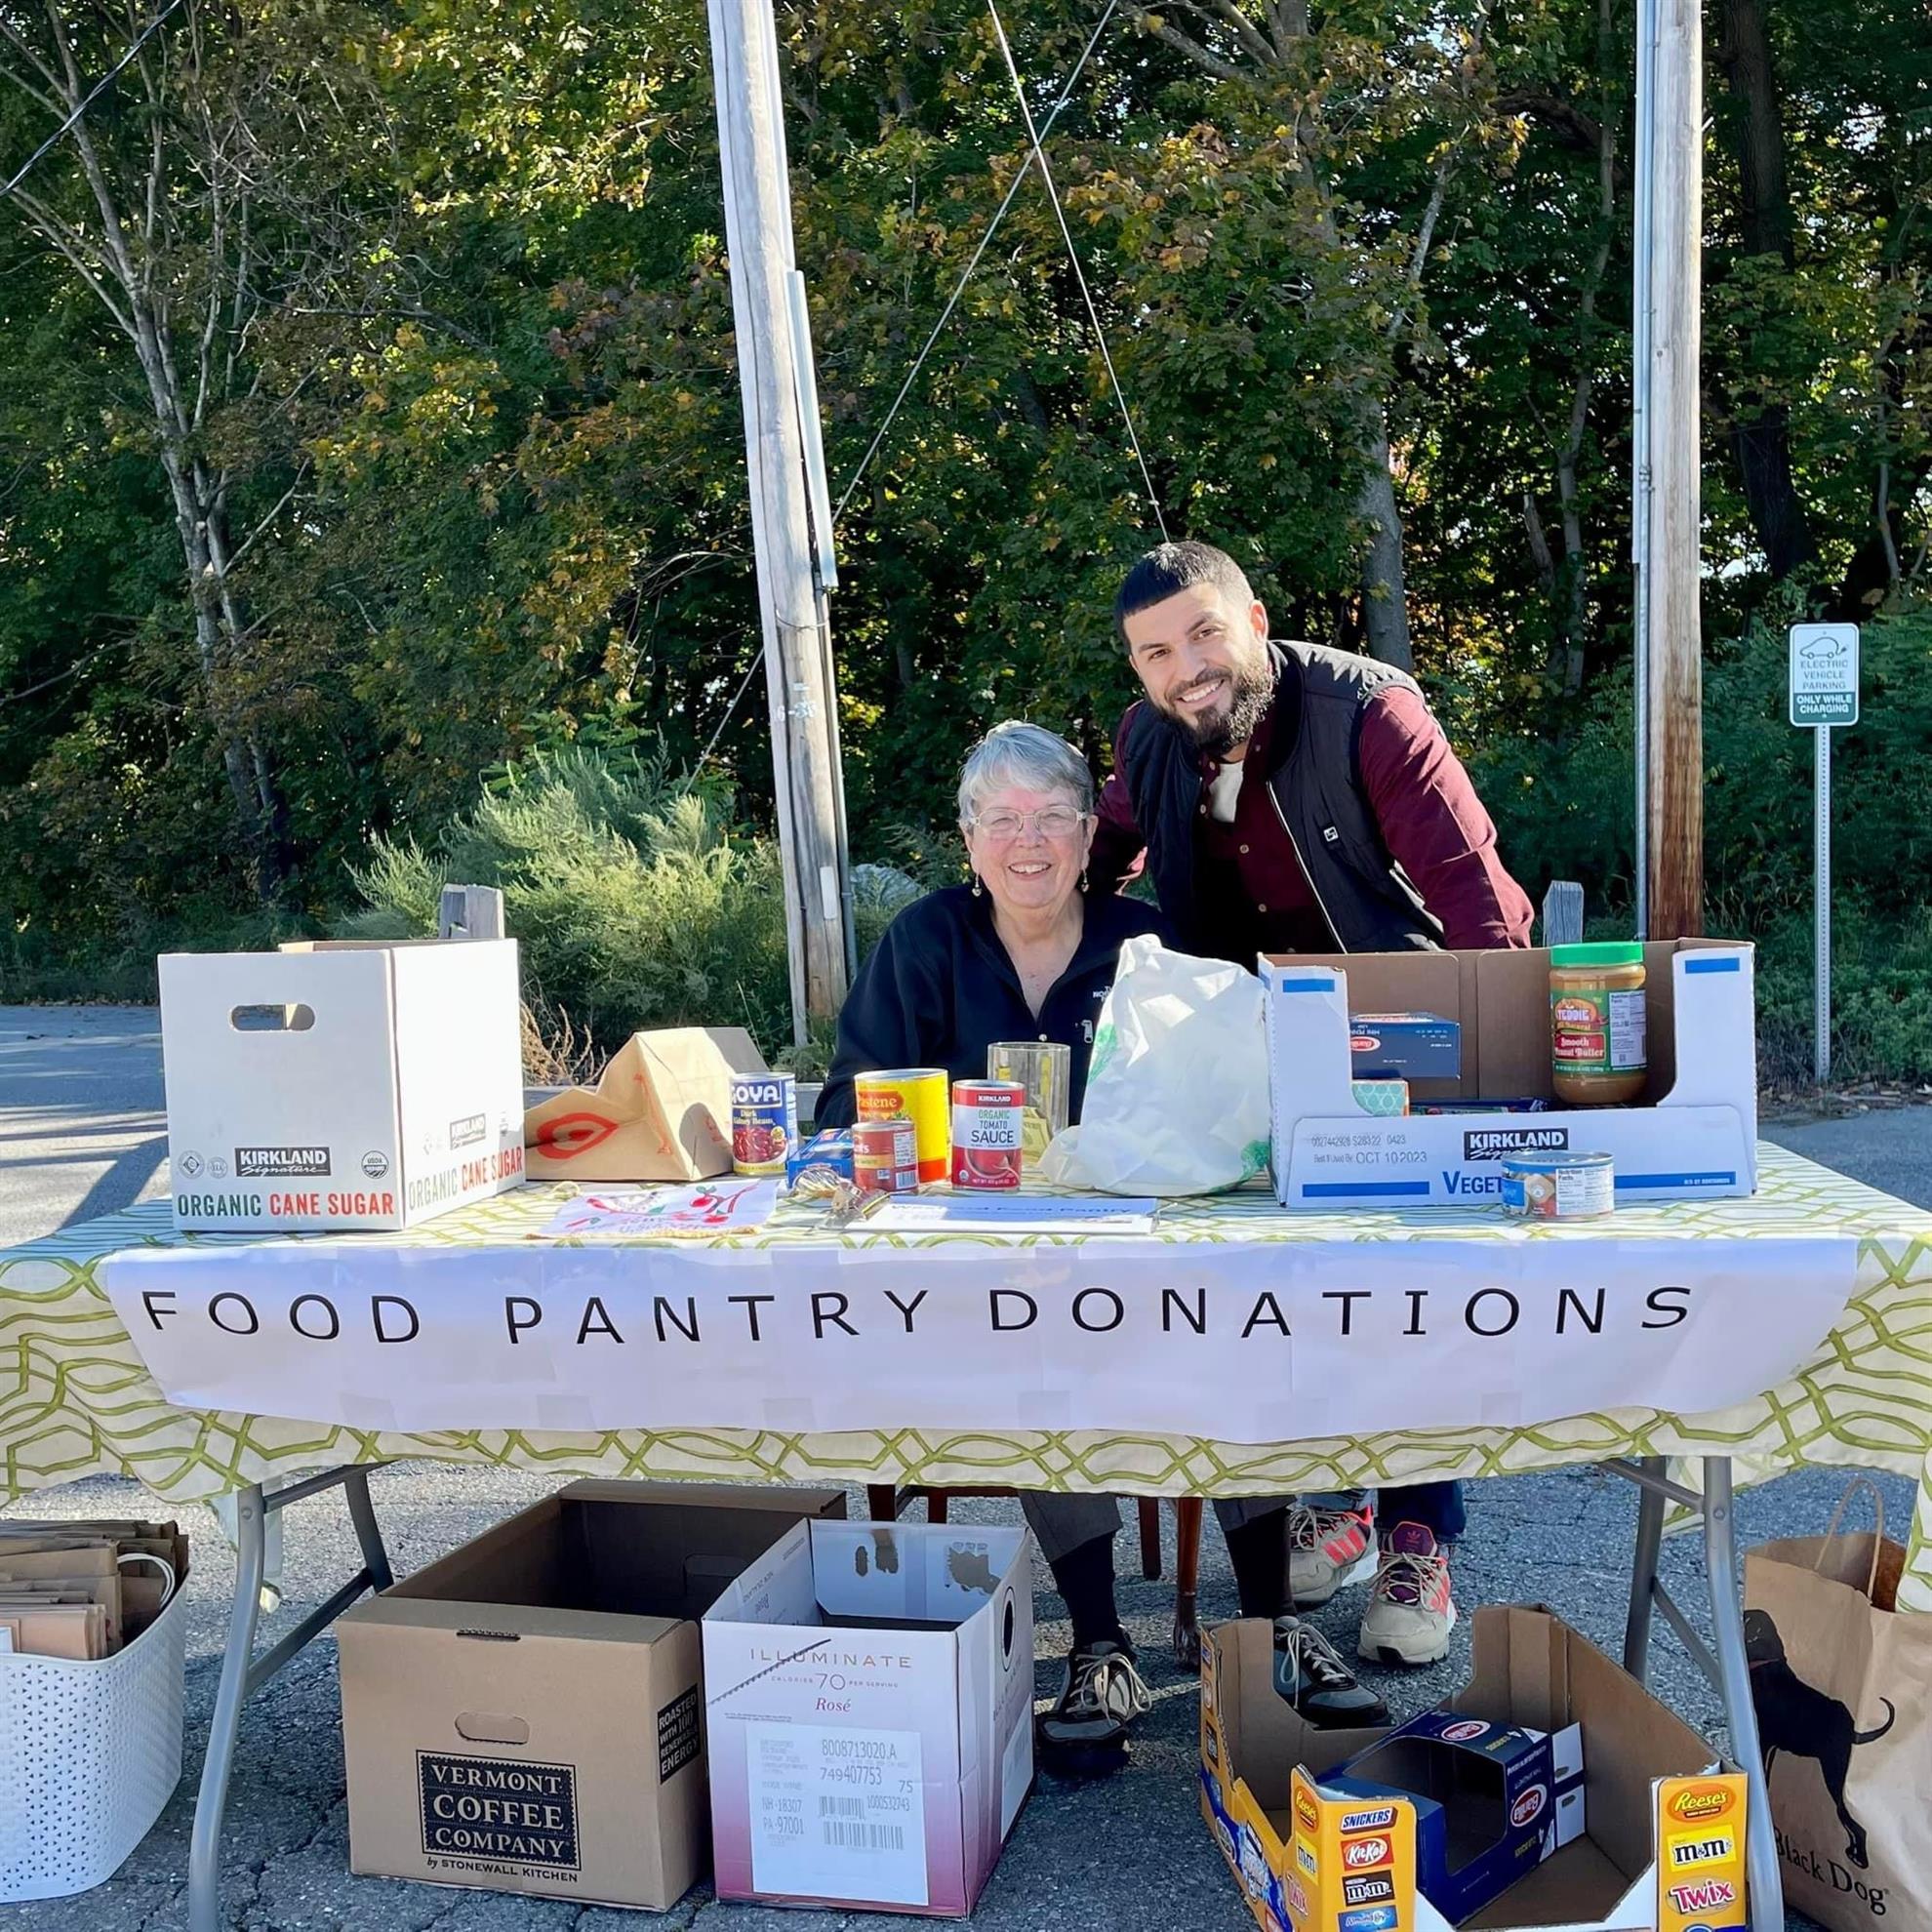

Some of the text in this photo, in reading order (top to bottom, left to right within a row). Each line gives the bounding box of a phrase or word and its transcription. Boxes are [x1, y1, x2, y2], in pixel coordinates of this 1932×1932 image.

[1803, 681, 1845, 690] PARKING
[1797, 694, 1852, 704] ONLY WHILE
[1800, 704, 1849, 713] CHARGING
[1561, 1037, 1590, 1047] Smooth
[1575, 1047, 1604, 1057] Butter
[979, 1110, 1010, 1119] ORGANIC
[971, 1131, 1014, 1144] SAUCE
[1469, 1132, 1564, 1148] KIRKLAND
[240, 1150, 327, 1165] KIRKLAND
[1356, 1152, 1380, 1164] OCT
[239, 1163, 329, 1178] Signature
[409, 1146, 523, 1210] ORGANIC CANE SUGAR
[1442, 1171, 1502, 1194] VEGET
[178, 1192, 394, 1217] ORGANIC CANE SUGAR
[141, 1286, 1692, 1345] FOOD PANTRY DONATIONS
[750, 1648, 911, 1669] ILLUMINATE
[815, 1673, 845, 1690] 70
[659, 1694, 697, 1731] ROASTED
[815, 1697, 851, 1712] Rosé
[660, 1724, 677, 1746] WITH
[662, 1739, 698, 1776] ENERGY
[430, 1764, 562, 1794] VERMONT
[432, 1794, 564, 1830] COFFEE
[1674, 1791, 1727, 1812] Reese's
[1343, 1810, 1390, 1828] SNICKERS
[435, 1828, 566, 1858] COMPANY
[426, 1857, 578, 1882] by STONEWALL KITCHEN
[1670, 1879, 1734, 1912] Twix
[1827, 1858, 1886, 1915] Dog
